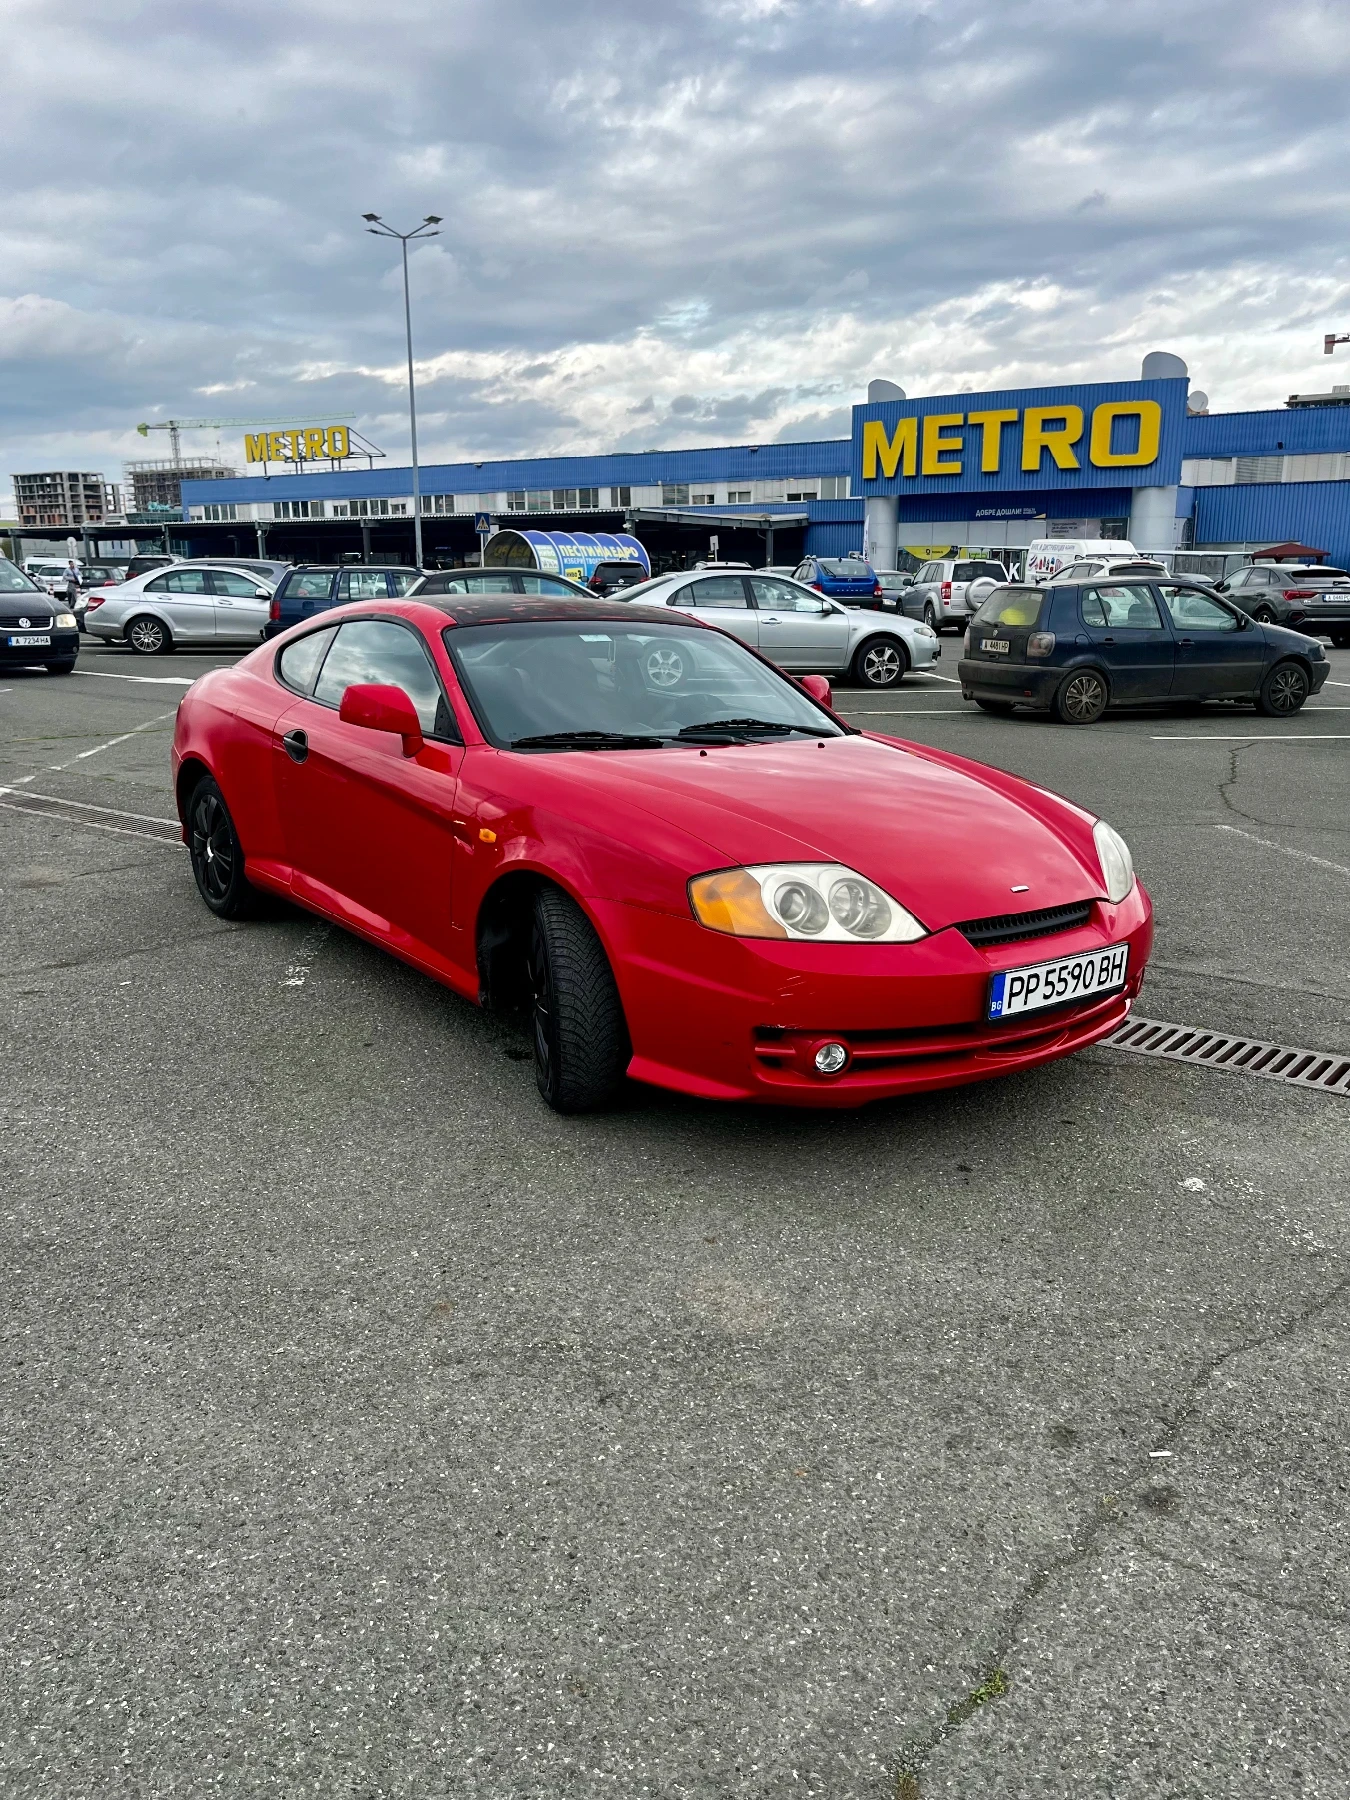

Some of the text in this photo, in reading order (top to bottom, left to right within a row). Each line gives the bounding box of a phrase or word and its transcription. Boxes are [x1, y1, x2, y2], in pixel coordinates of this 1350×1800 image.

[244, 425, 349, 463] METRO
[863, 400, 1161, 479] METRO
[975, 509, 996, 517] ДОБРЕ
[558, 545, 593, 557] ПЕСТИ
[593, 545, 611, 557] НА
[611, 546, 639, 559] ЕДРО
[1007, 950, 1124, 1009] PP 5590 BH
[990, 1000, 1002, 1012] BG
